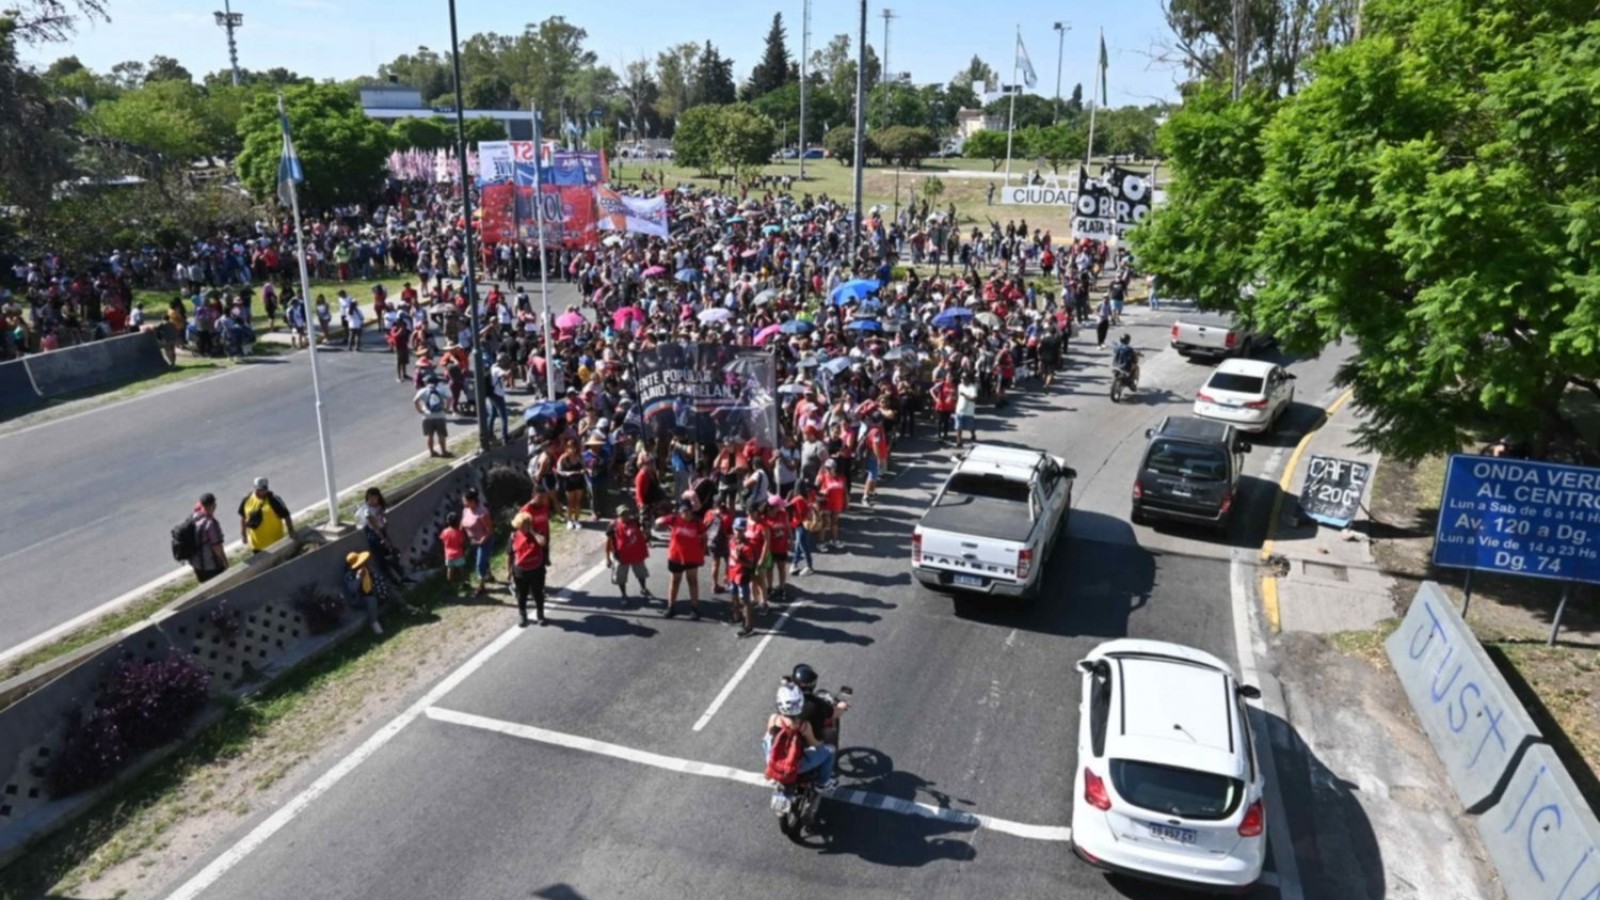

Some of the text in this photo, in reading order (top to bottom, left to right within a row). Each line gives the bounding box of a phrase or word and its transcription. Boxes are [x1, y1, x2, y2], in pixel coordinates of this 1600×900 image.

[1077, 219, 1105, 234] PLATA
[1473, 463, 1539, 484] ONDA
[1476, 482, 1507, 499] AL
[1450, 498, 1474, 510] Lun
[1478, 501, 1486, 510] a
[1490, 501, 1516, 514] Sab
[1520, 505, 1537, 517] de
[1543, 507, 1552, 518] 6
[1555, 510, 1564, 520] a
[1569, 510, 1584, 521] 14
[1455, 513, 1591, 545] Av. 120 a Dg.
[1440, 532, 1598, 559] Lun a Vie de 14 a 23 Hs
[923, 554, 1015, 575] RANGER
[1494, 551, 1561, 573] Dg. 74
